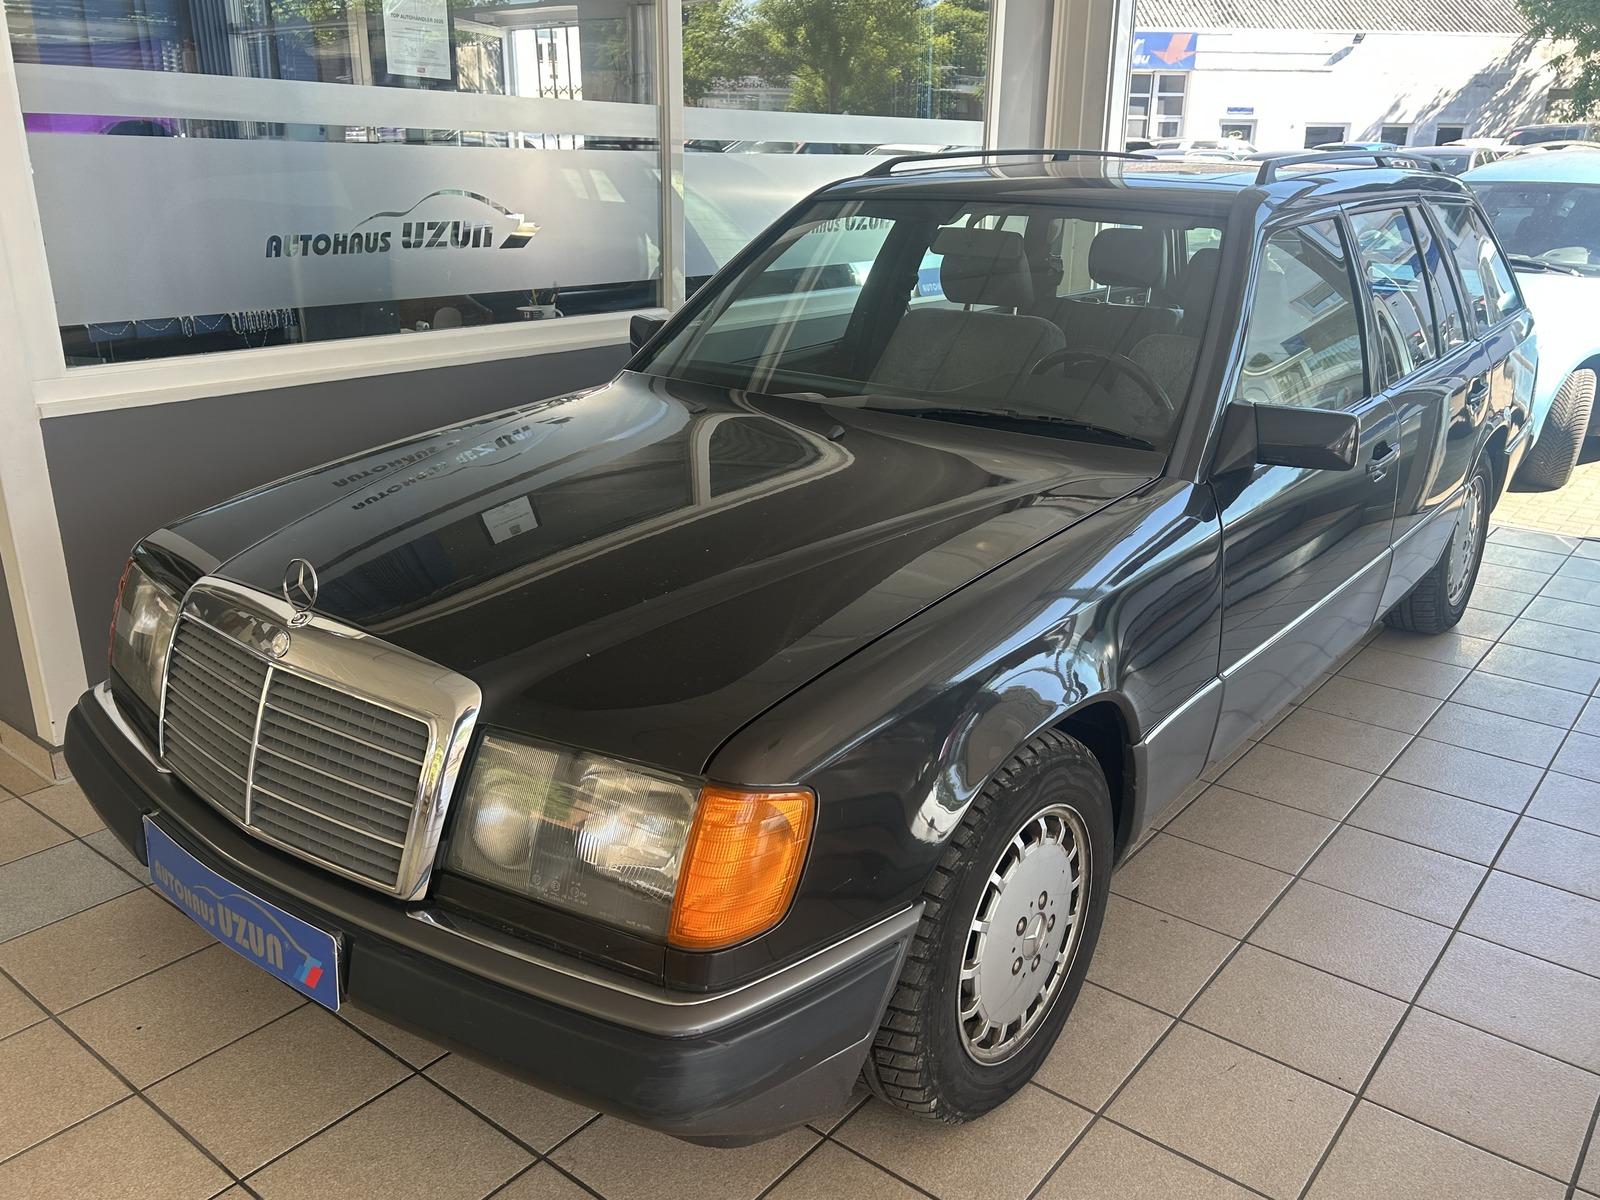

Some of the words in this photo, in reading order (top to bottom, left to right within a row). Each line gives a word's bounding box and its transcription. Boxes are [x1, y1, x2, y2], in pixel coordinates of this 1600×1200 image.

[265, 231, 392, 258] AUTOHAUS
[401, 220, 494, 249] UZUN
[154, 859, 216, 927] AUTOHAUS
[216, 902, 284, 970] UZUN
